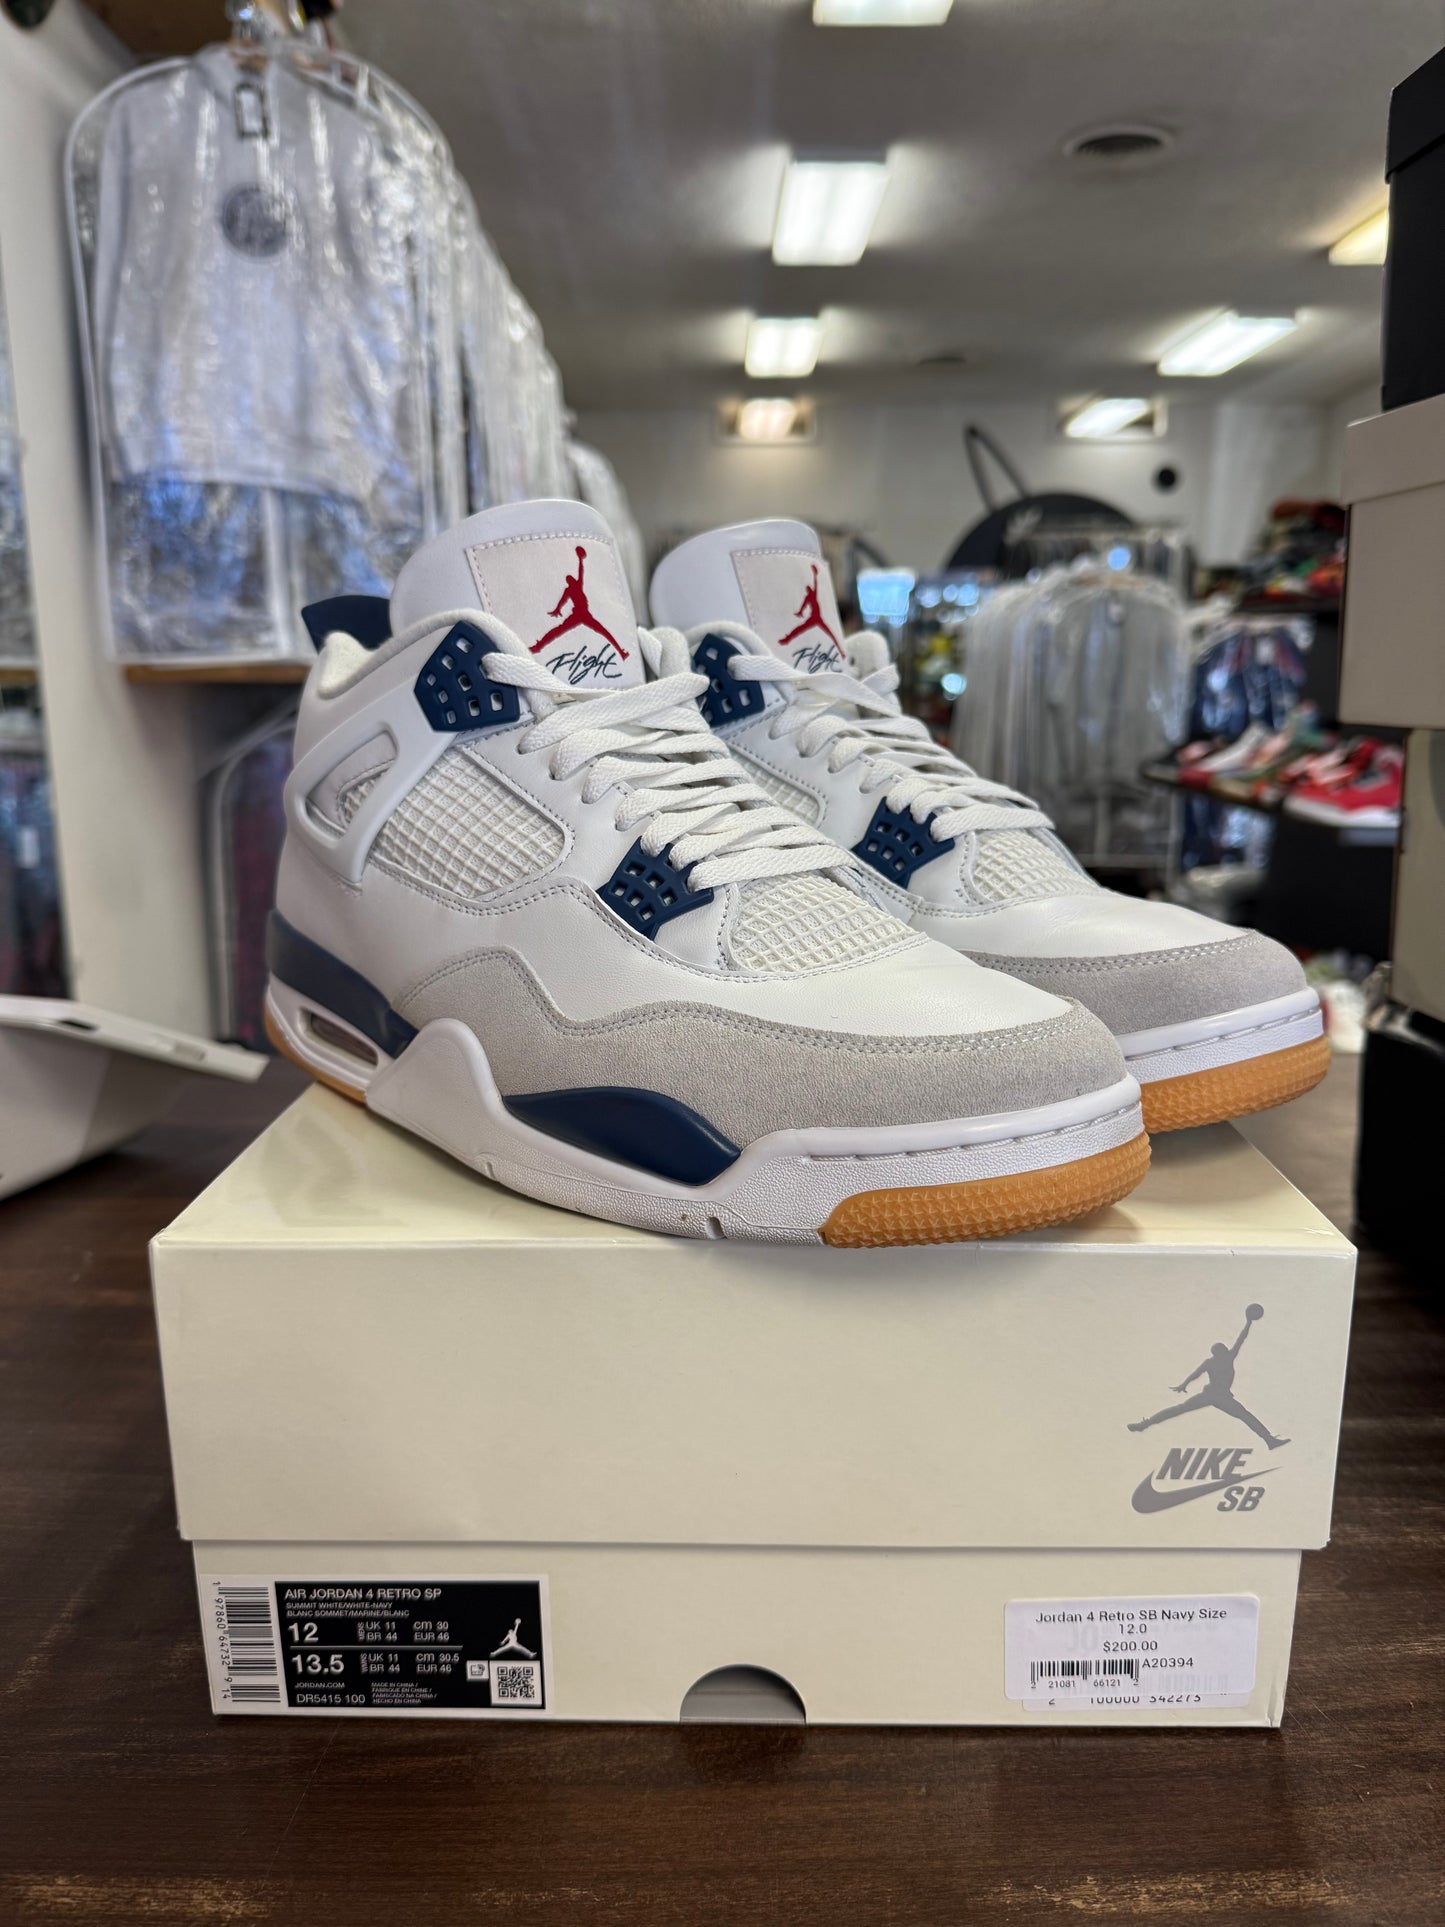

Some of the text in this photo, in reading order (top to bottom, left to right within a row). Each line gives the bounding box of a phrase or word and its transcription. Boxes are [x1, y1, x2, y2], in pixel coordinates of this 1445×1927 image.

[792, 643, 843, 674] Flight
[546, 643, 622, 685] Flight
[1155, 1448, 1254, 1480] NIKE
[1216, 1486, 1265, 1512] SB
[285, 1588, 442, 1600] AIR JORDAN 4 RETRO SP
[215, 1597, 226, 1630] 97860
[1036, 1608, 1227, 1623] Jordan 4 Retro SB Navy Size
[366, 1621, 396, 1630] UK 11
[436, 1621, 449, 1630] 30
[1118, 1624, 1147, 1634] 12.0
[288, 1622, 319, 1642] 12
[367, 1632, 398, 1641] BR 44
[414, 1632, 450, 1641] EUR 46
[219, 1635, 231, 1666] 64732
[1103, 1640, 1158, 1652] $200.00
[368, 1653, 399, 1662] UK 11
[439, 1653, 460, 1662] 30.5
[291, 1653, 345, 1674] 13.5
[370, 1664, 400, 1672] BR 44
[417, 1664, 452, 1672] EUR 46
[1142, 1658, 1194, 1668] A20394
[1030, 1681, 1037, 1689] 2
[1048, 1680, 1076, 1688] 21081
[1093, 1679, 1121, 1687] 66121
[297, 1693, 366, 1703] DR5415 100
